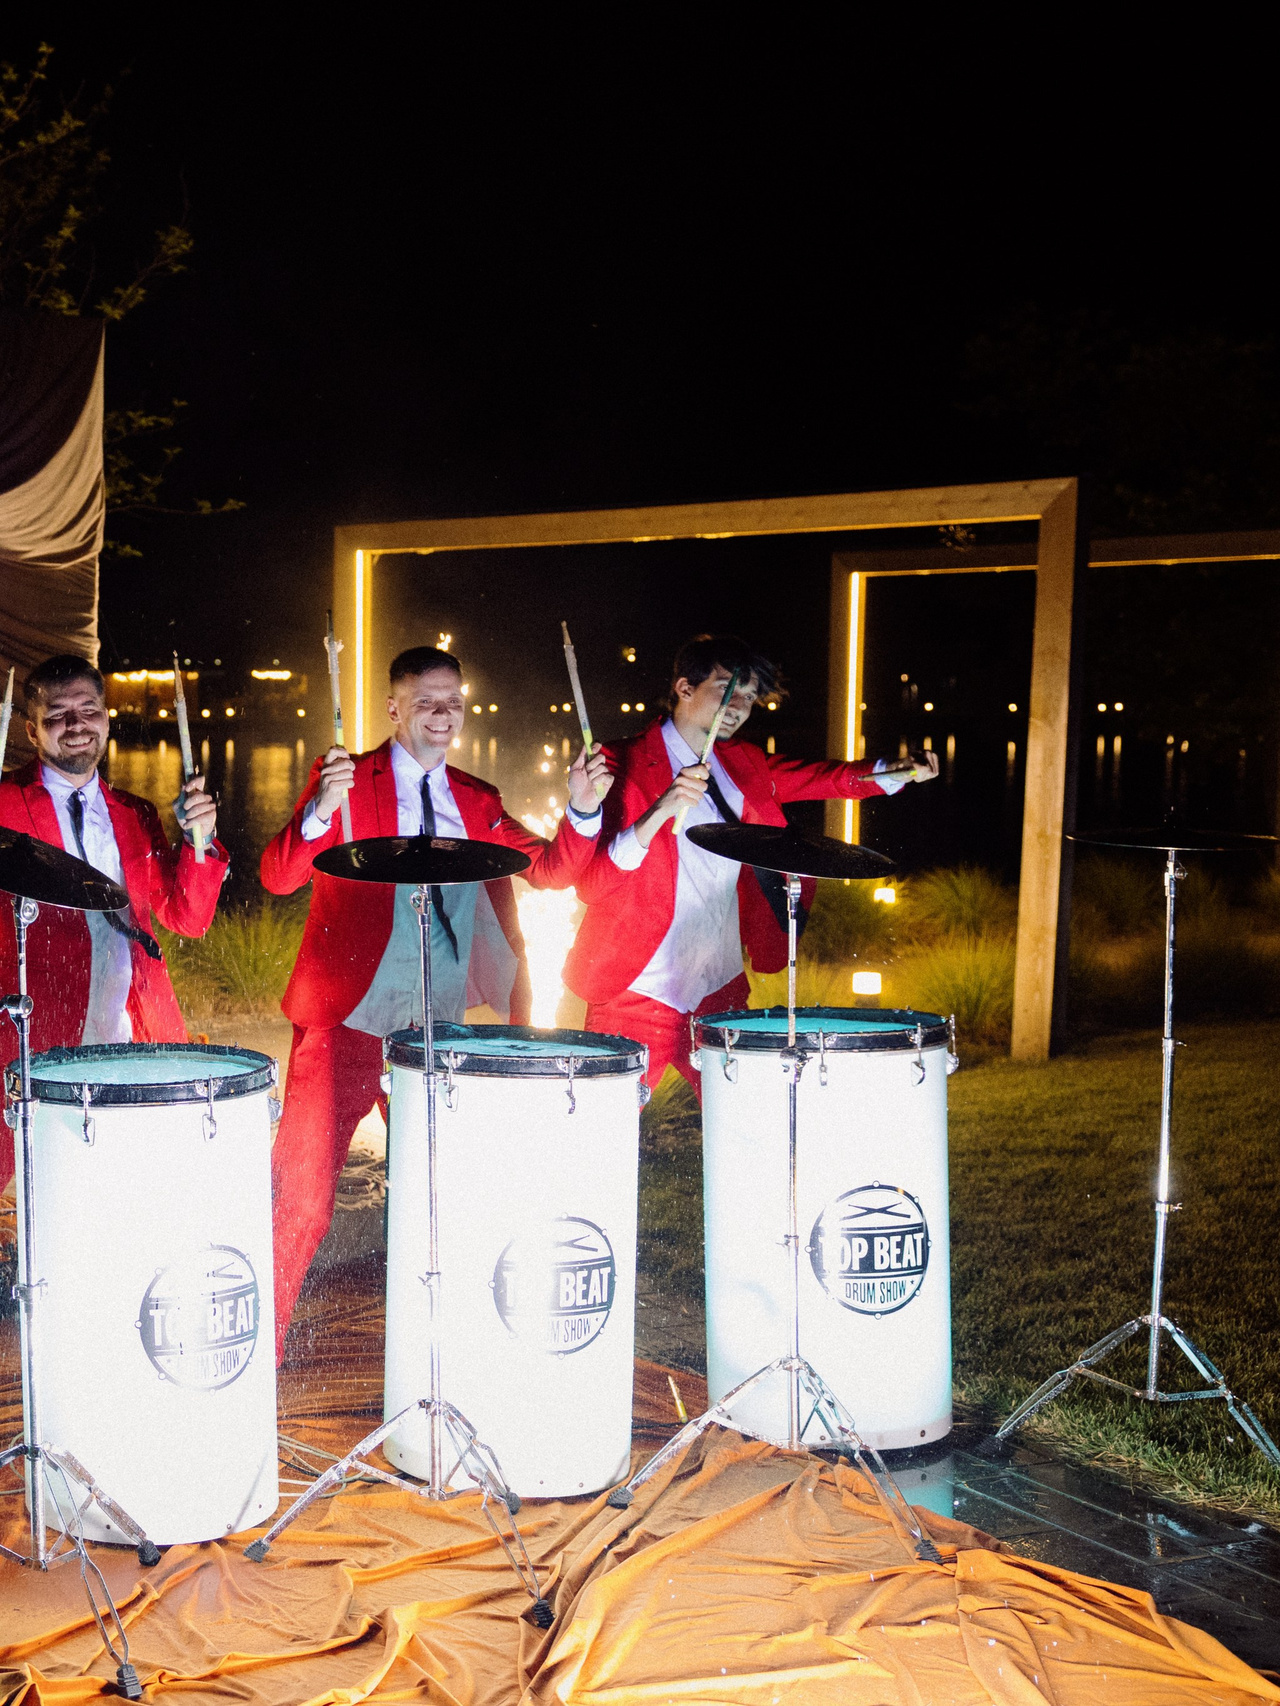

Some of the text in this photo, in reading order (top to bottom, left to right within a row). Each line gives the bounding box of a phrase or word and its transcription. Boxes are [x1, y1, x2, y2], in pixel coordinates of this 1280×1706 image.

[873, 1232, 924, 1271] BEAT
[559, 1266, 611, 1308] BEAT
[845, 1280, 907, 1304] DRUM SHOW
[207, 1292, 256, 1341] BEAT
[563, 1317, 591, 1343] SHOW
[213, 1348, 240, 1377] SHOW
